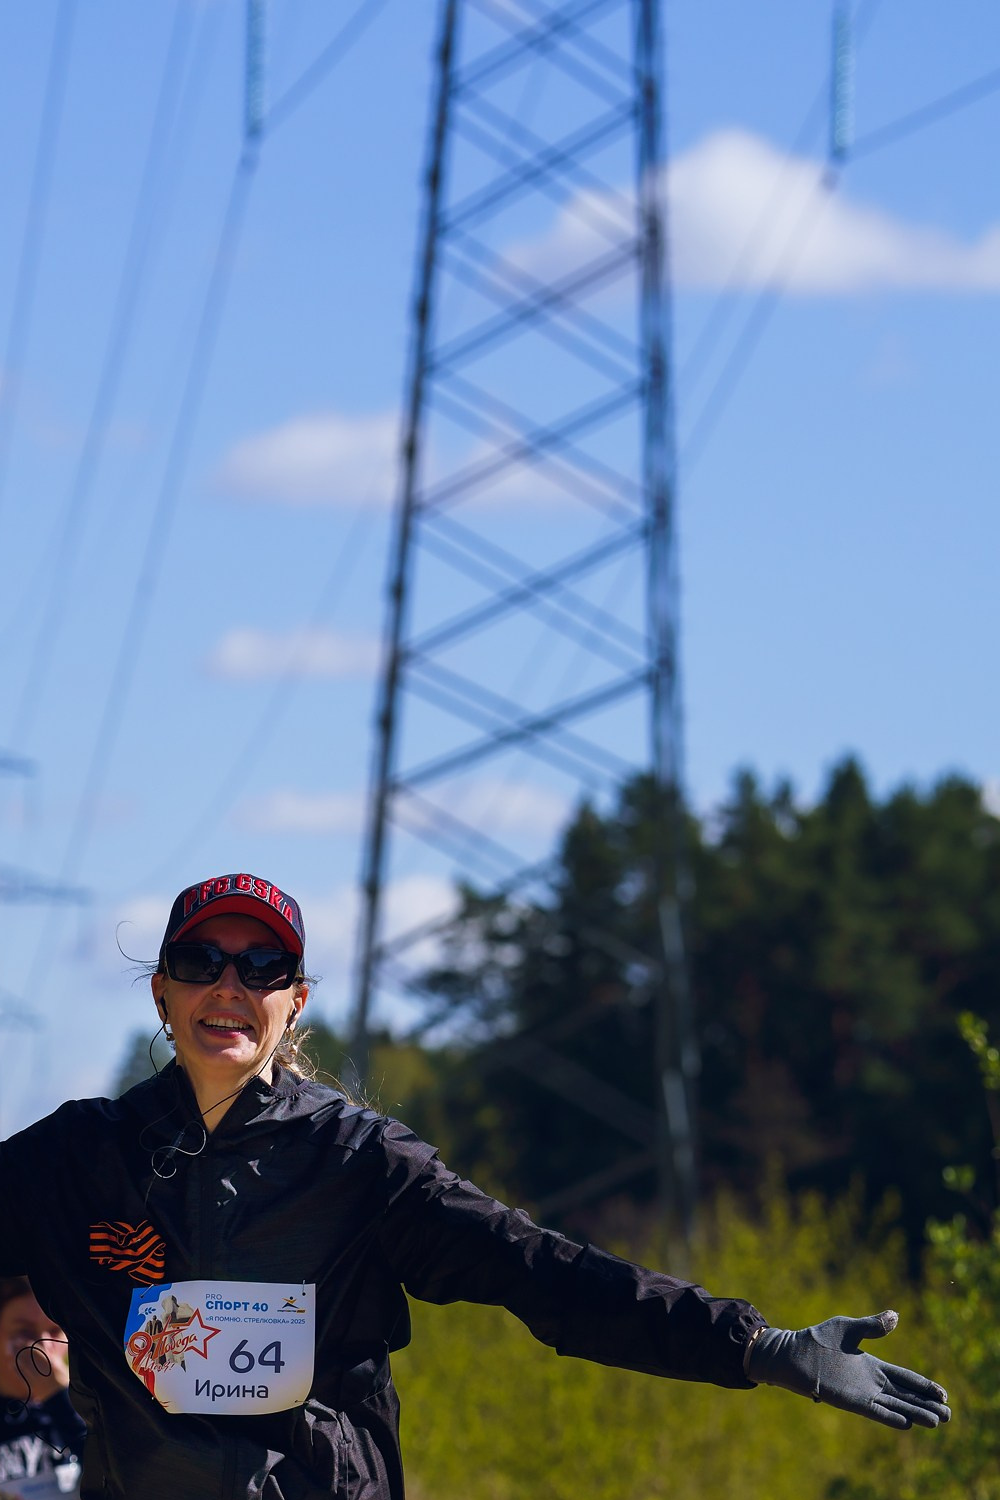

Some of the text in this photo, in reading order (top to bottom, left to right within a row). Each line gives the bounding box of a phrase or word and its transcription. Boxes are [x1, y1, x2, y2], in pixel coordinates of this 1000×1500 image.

[184, 873, 293, 924] PFC CSKA
[205, 1300, 250, 1311] СПОРТ
[252, 1303, 269, 1312] 40
[229, 1339, 286, 1374] 64
[195, 1379, 269, 1402] Ирина
